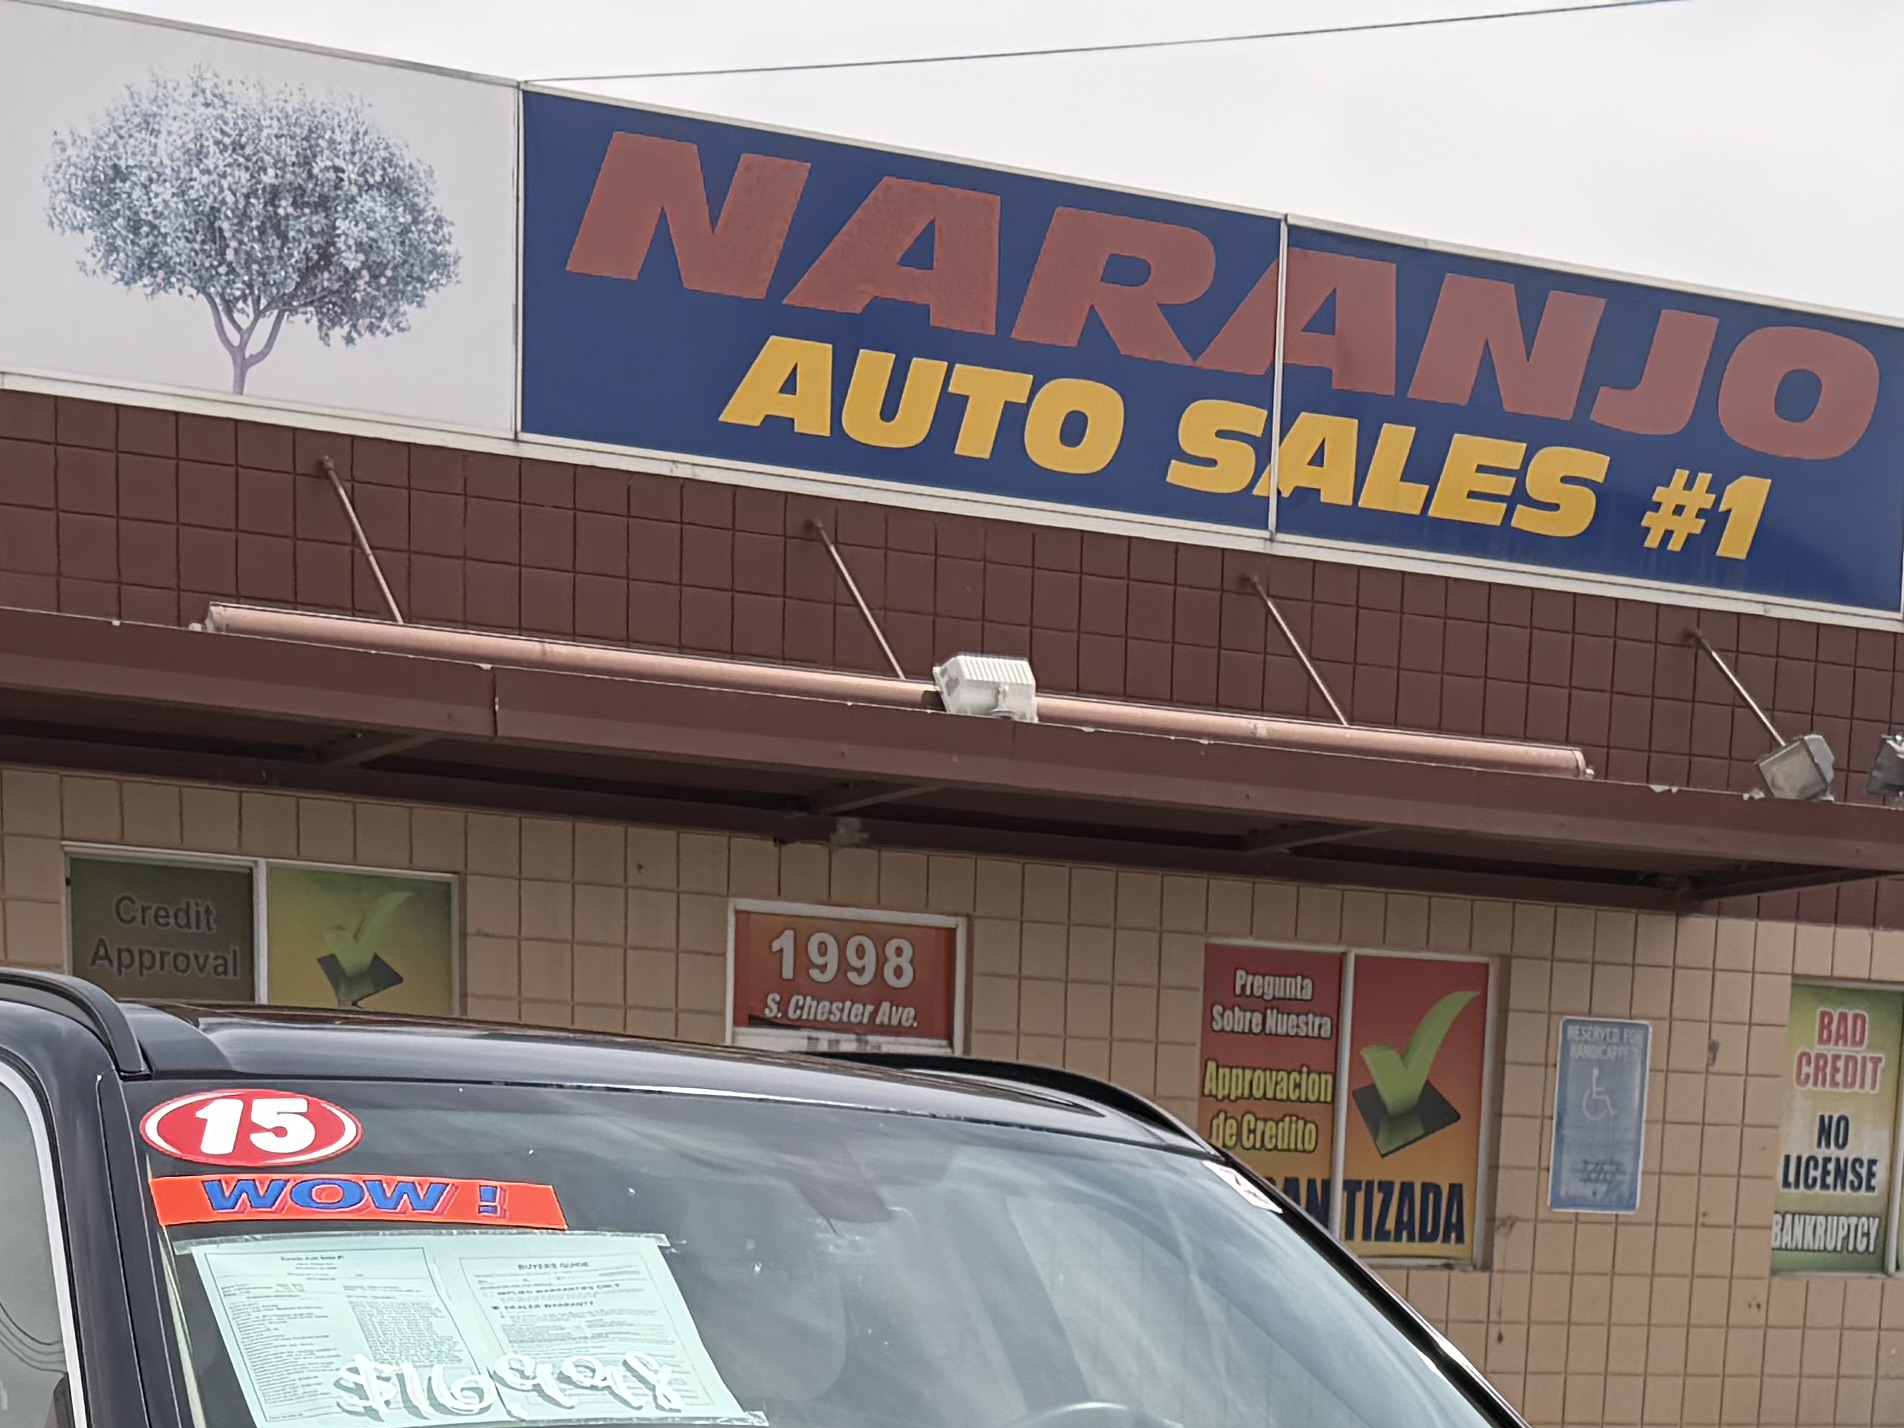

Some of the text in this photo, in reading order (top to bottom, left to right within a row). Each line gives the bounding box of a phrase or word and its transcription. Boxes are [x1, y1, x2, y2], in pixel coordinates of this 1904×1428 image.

[566, 131, 1880, 459] NARANJO
[719, 335, 1771, 560] AUTO SALES #1
[115, 896, 214, 932] Credit
[90, 938, 239, 978] Approval
[772, 929, 914, 988] 1998
[1235, 969, 1313, 1001] Pregunta
[764, 992, 918, 1028] S. Chester Ave.
[1212, 1004, 1332, 1039] Sobre Nuestra
[1816, 1009, 1868, 1049] BAD
[1203, 1060, 1334, 1102] Approvacion
[1795, 1051, 1884, 1091] CREDIT
[195, 1097, 316, 1155] 15
[1211, 1111, 1318, 1153] de Credito
[1816, 1114, 1850, 1150] NO
[1781, 1154, 1879, 1193] LICENSE
[1772, 1213, 1880, 1253] BANKRUPTCY
